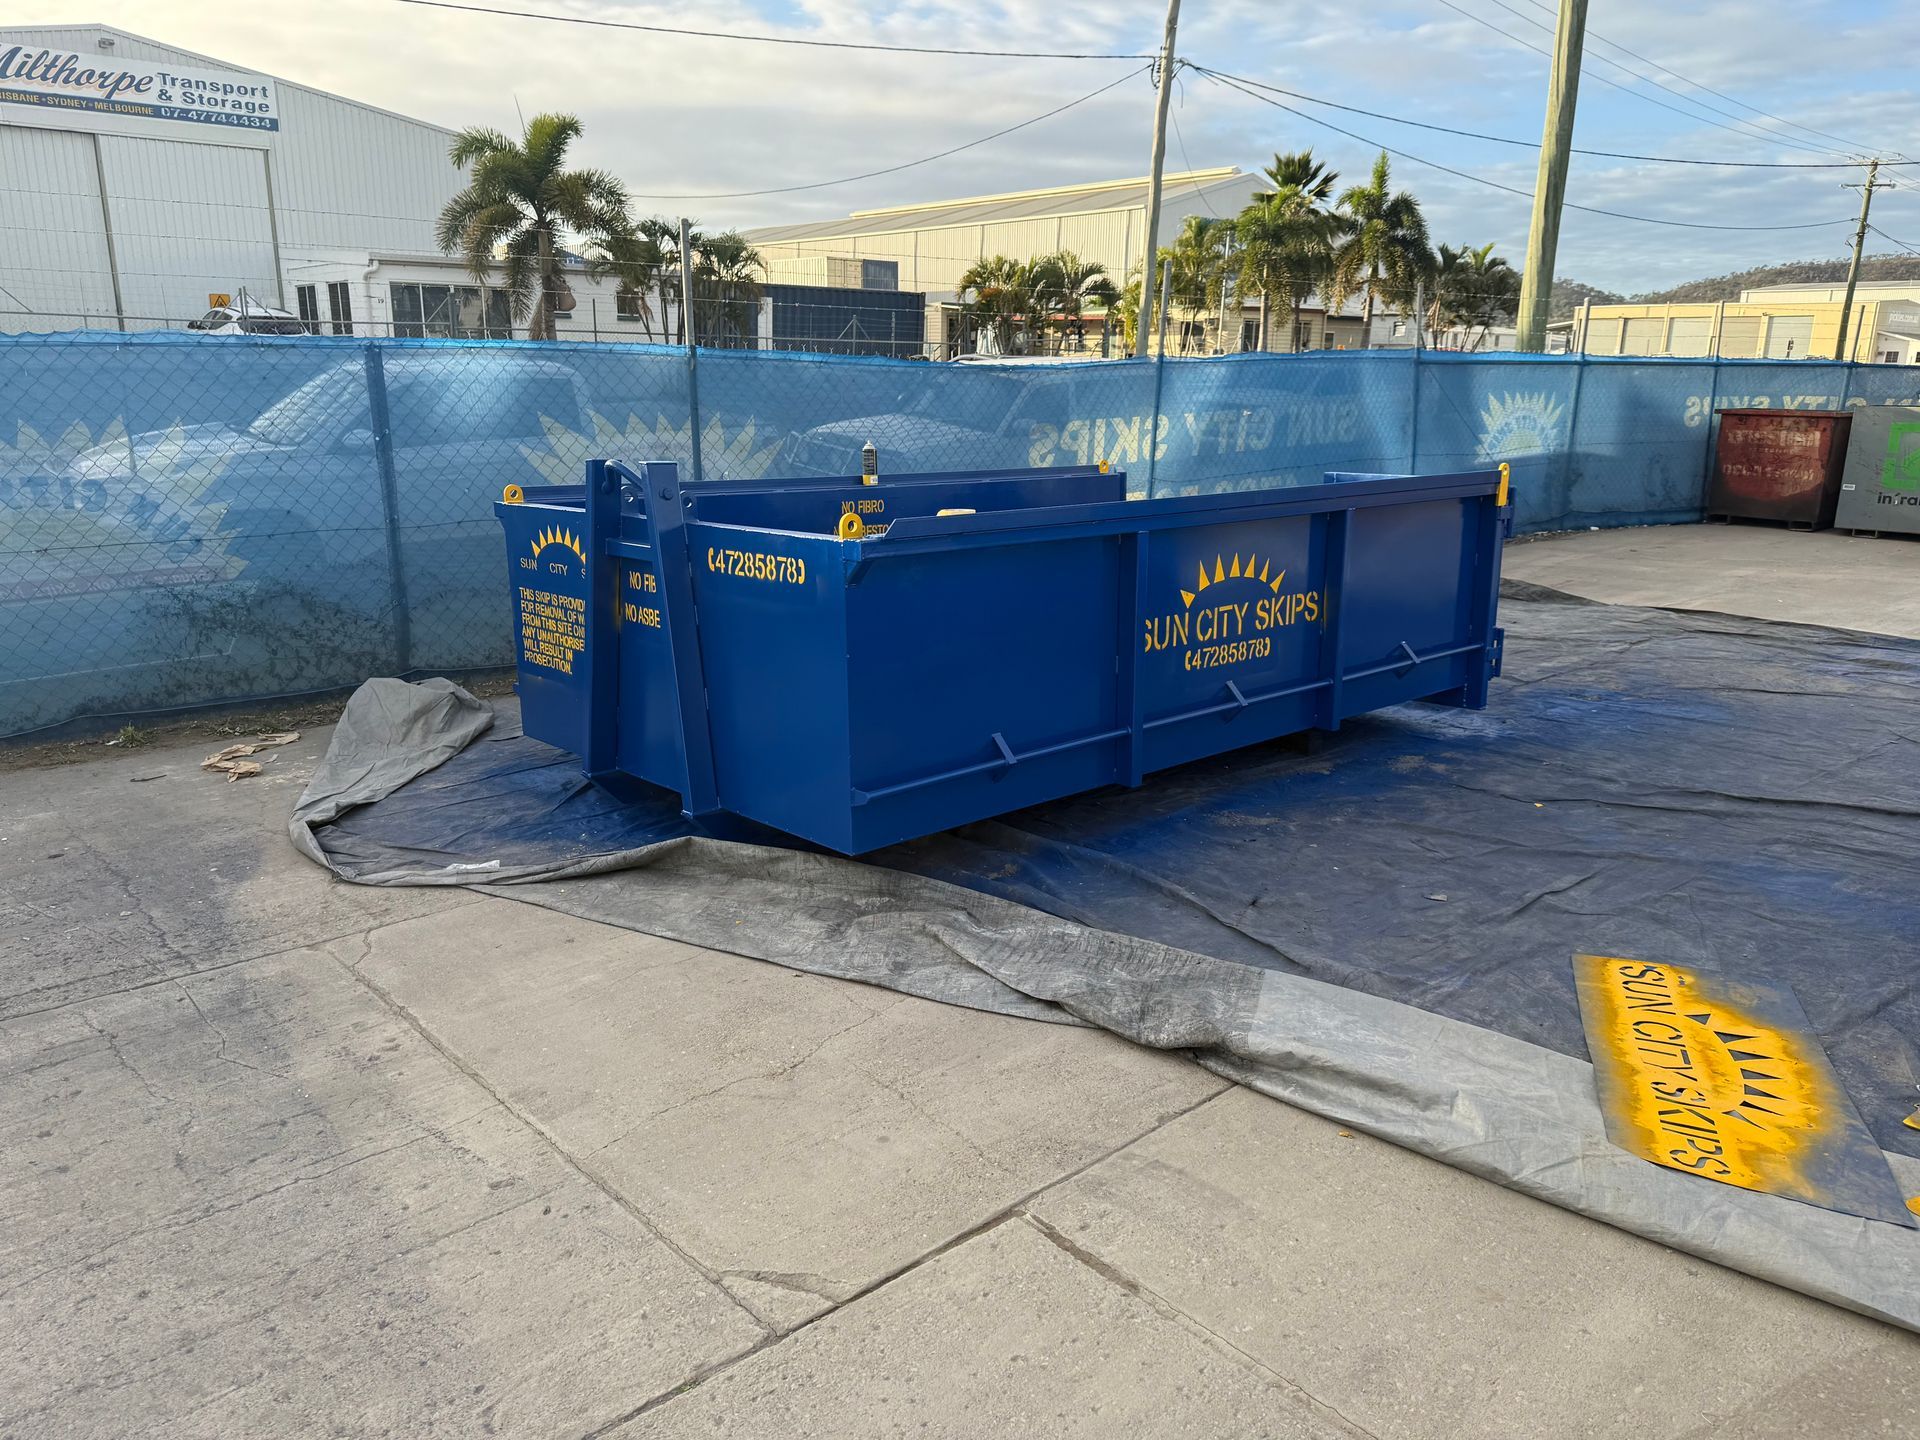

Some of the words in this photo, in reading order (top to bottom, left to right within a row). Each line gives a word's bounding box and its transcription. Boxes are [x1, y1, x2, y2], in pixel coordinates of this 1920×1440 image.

[157, 72, 269, 98] Transport
[47, 96, 87, 108] SYDNEY
[94, 101, 154, 116] MELBOURNE
[157, 88, 173, 102] &
[182, 91, 270, 114] Storage
[161, 107, 271, 128] 07-47744434
[841, 501, 855, 514] NO
[858, 499, 885, 514] FIBRO
[520, 556, 538, 571] SUN
[549, 562, 568, 576] CITY
[629, 570, 642, 590] NO
[519, 587, 534, 600] THIS
[535, 590, 551, 604] SKIP
[551, 593, 558, 606] IS
[521, 599, 534, 613] FOR
[535, 602, 567, 621] REMOVAL
[567, 610, 577, 623] OF
[625, 602, 638, 623] NO
[1145, 612, 1190, 653] SUN
[1196, 602, 1249, 642] CITY
[1255, 591, 1319, 631] SKIPS
[521, 612, 541, 628] FROM
[541, 616, 556, 631] THIS
[557, 621, 573, 636] SITE
[522, 625, 536, 639] ANY
[537, 628, 586, 652] UNAUTHORISE
[523, 637, 539, 652] WILL
[539, 641, 565, 659] RESULT
[565, 648, 574, 661] IN
[1619, 964, 1677, 1016] SUN
[1632, 1020, 1699, 1083] CITY
[1650, 1081, 1732, 1176] SKIPS
